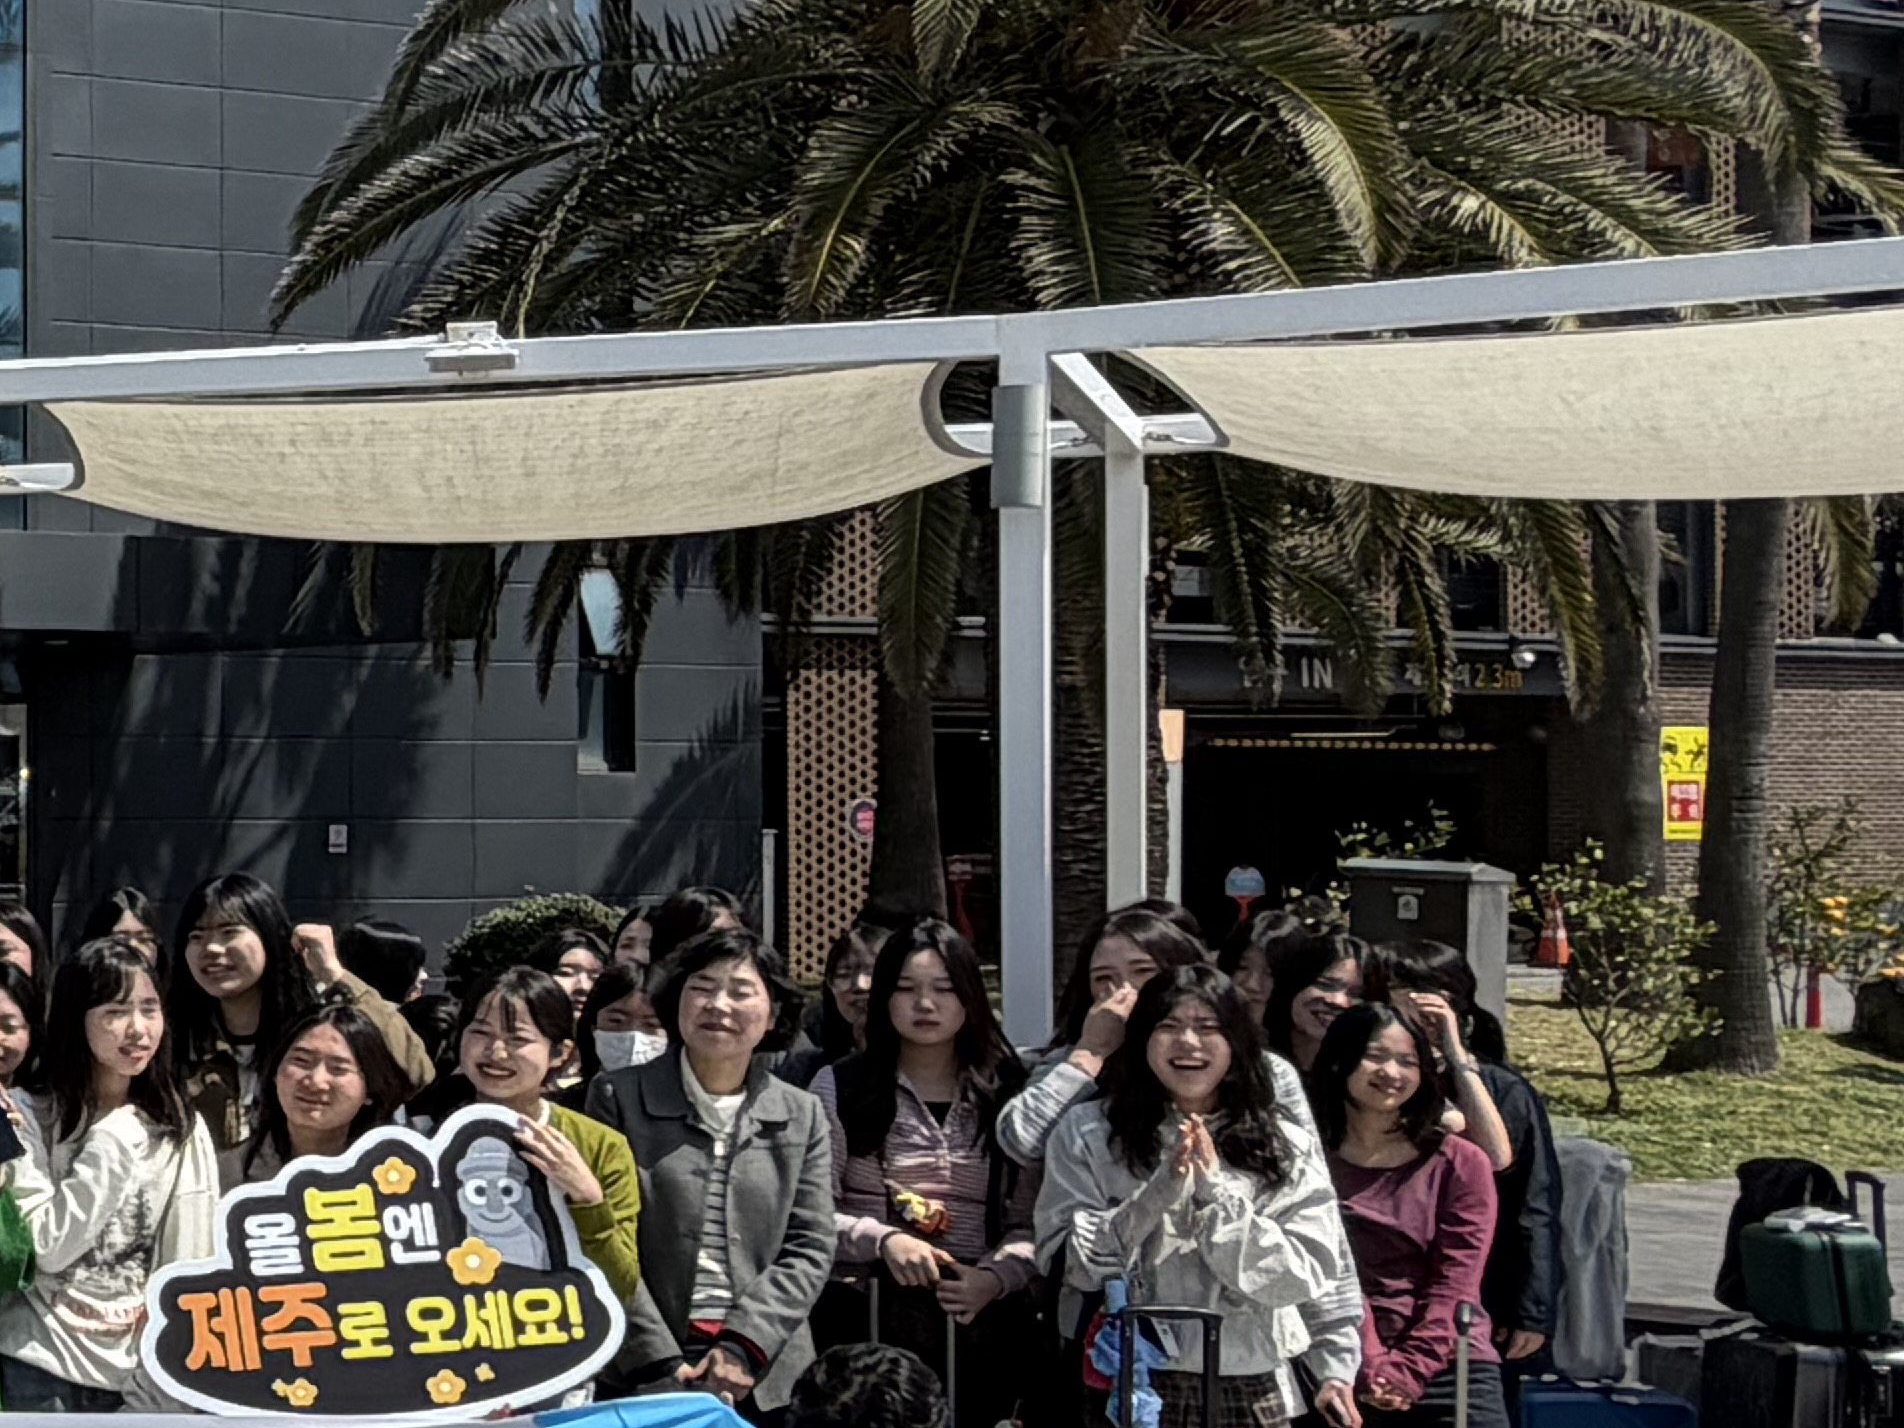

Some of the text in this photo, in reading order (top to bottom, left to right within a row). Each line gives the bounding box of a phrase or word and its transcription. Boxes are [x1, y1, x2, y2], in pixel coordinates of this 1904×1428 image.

[1300, 656, 1333, 690] IN
[177, 1281, 586, 1373] 제주로 오세요!
